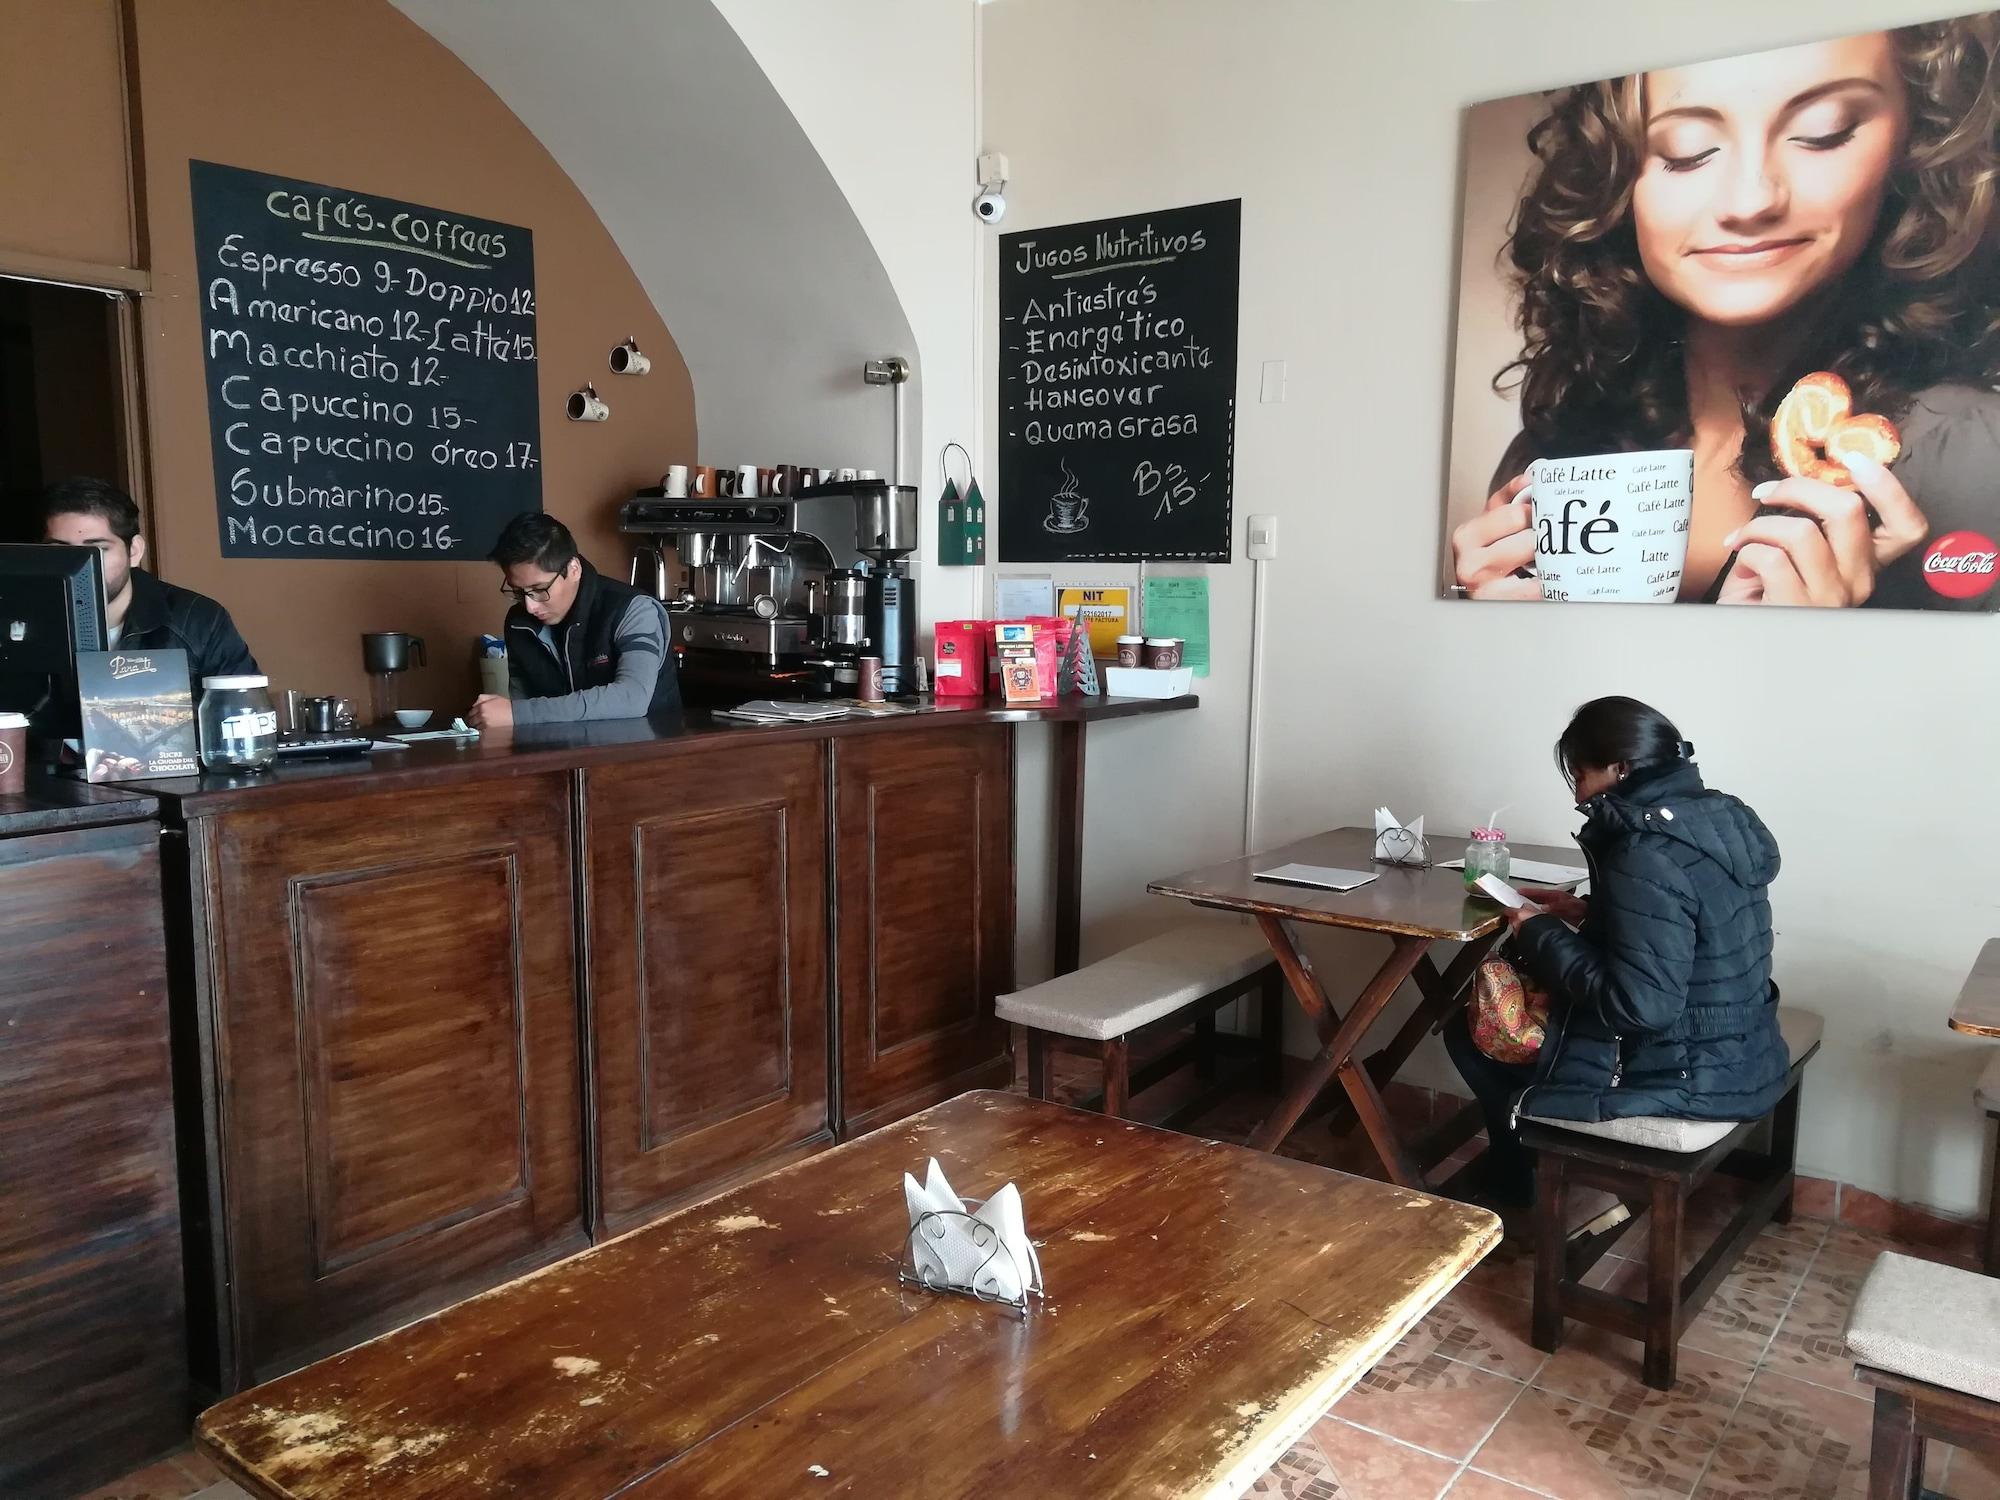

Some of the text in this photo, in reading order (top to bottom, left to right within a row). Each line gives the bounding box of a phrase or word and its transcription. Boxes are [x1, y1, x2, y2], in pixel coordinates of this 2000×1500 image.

[1095, 222, 1208, 262] Nutritivos
[218, 233, 362, 291] Espresso
[404, 267, 507, 314] Doppio
[208, 277, 384, 337] Americano
[1021, 275, 1159, 325] Antiestrés
[209, 328, 400, 383] Macchiato
[220, 374, 414, 424] Capuccino
[224, 421, 413, 464] Capuccino
[1540, 466, 1617, 483] Café Latte
[230, 466, 414, 514] Submarino
[1627, 479, 1679, 494] Café Latte
[1638, 498, 1685, 512] Café Latte
[226, 514, 415, 546] Mocaccino
[1536, 499, 1619, 555] afé
[1641, 549, 1670, 563] Latte
[1924, 551, 1998, 574] Coca-Cola
[1542, 570, 1561, 581] Latte
[1576, 565, 1622, 575] Café Latte
[1646, 572, 1665, 585] Café
[1083, 591, 1104, 601] NIT
[1542, 583, 1569, 602] Latte
[159, 751, 183, 759] SUCRE
[149, 763, 196, 772] CHOCOLATE
